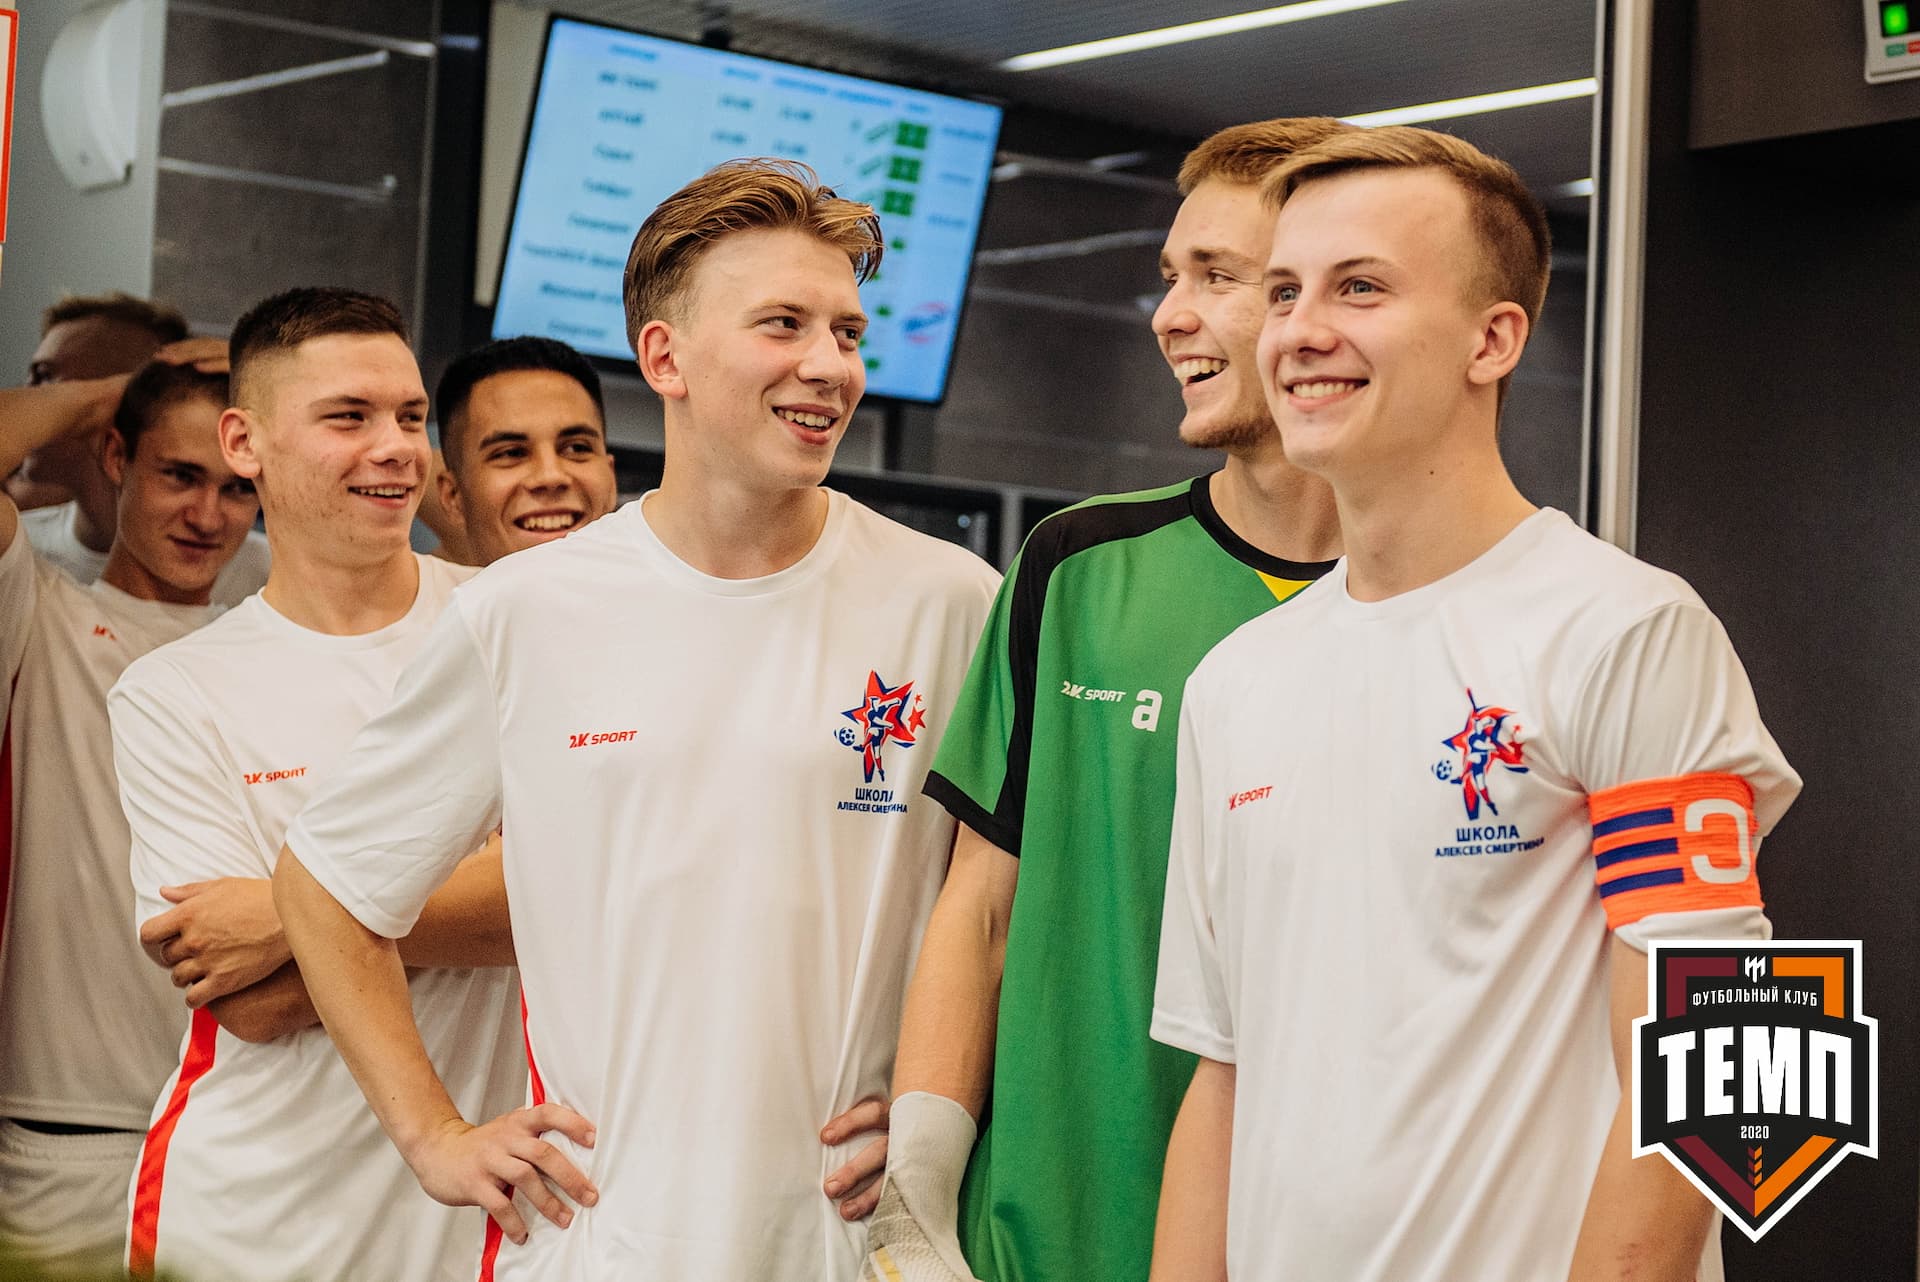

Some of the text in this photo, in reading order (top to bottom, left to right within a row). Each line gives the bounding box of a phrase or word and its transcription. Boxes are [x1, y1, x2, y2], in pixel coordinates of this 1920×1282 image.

[1084, 689, 1127, 703] SPORT
[1131, 689, 1163, 732] a
[591, 730, 638, 745] SPORT
[1456, 824, 1520, 842] ШКОЛА
[1435, 836, 1545, 857] АЛЕКСЕЯ СМЕРТИН
